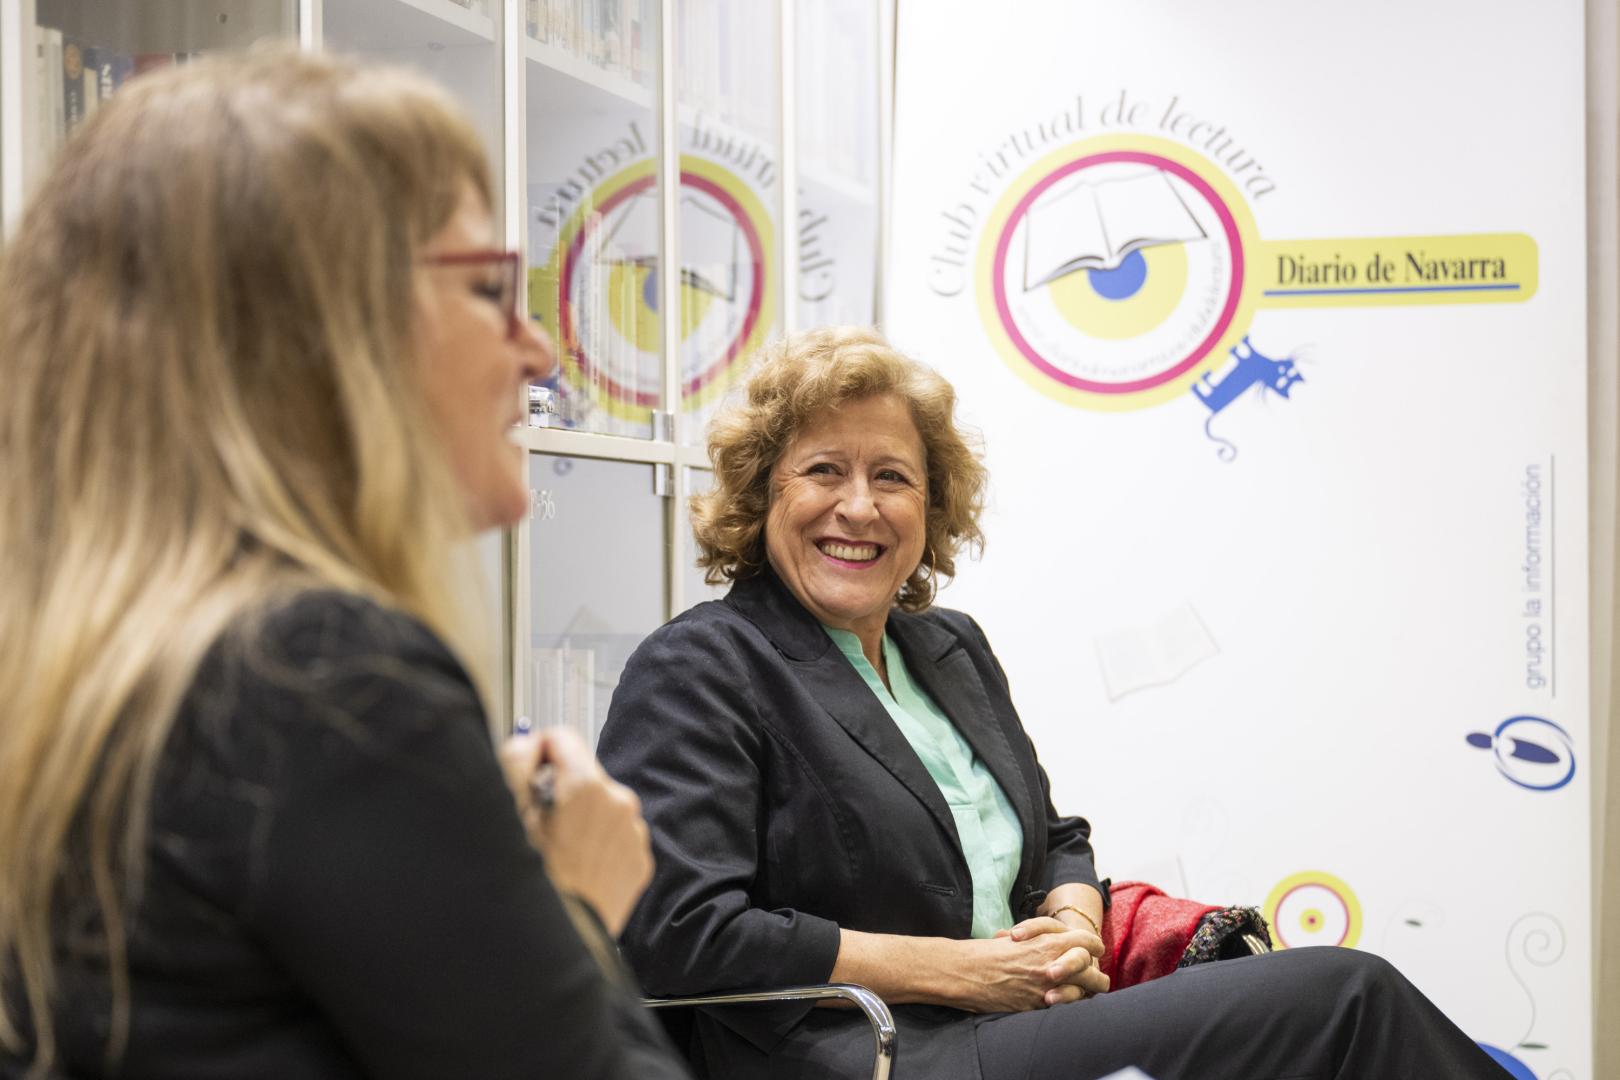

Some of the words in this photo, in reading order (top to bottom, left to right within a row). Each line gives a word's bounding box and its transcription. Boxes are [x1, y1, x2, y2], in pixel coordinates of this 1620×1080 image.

[927, 202, 977, 297] Club
[969, 95, 1087, 196] virtual
[1100, 89, 1146, 126] de
[1159, 95, 1276, 200] lectura
[1277, 253, 1356, 285] Diario
[1366, 252, 1395, 283] de
[1405, 250, 1506, 282] Navarra
[1521, 463, 1542, 592] información
[1522, 597, 1542, 618] la
[1525, 623, 1546, 690] grupo
